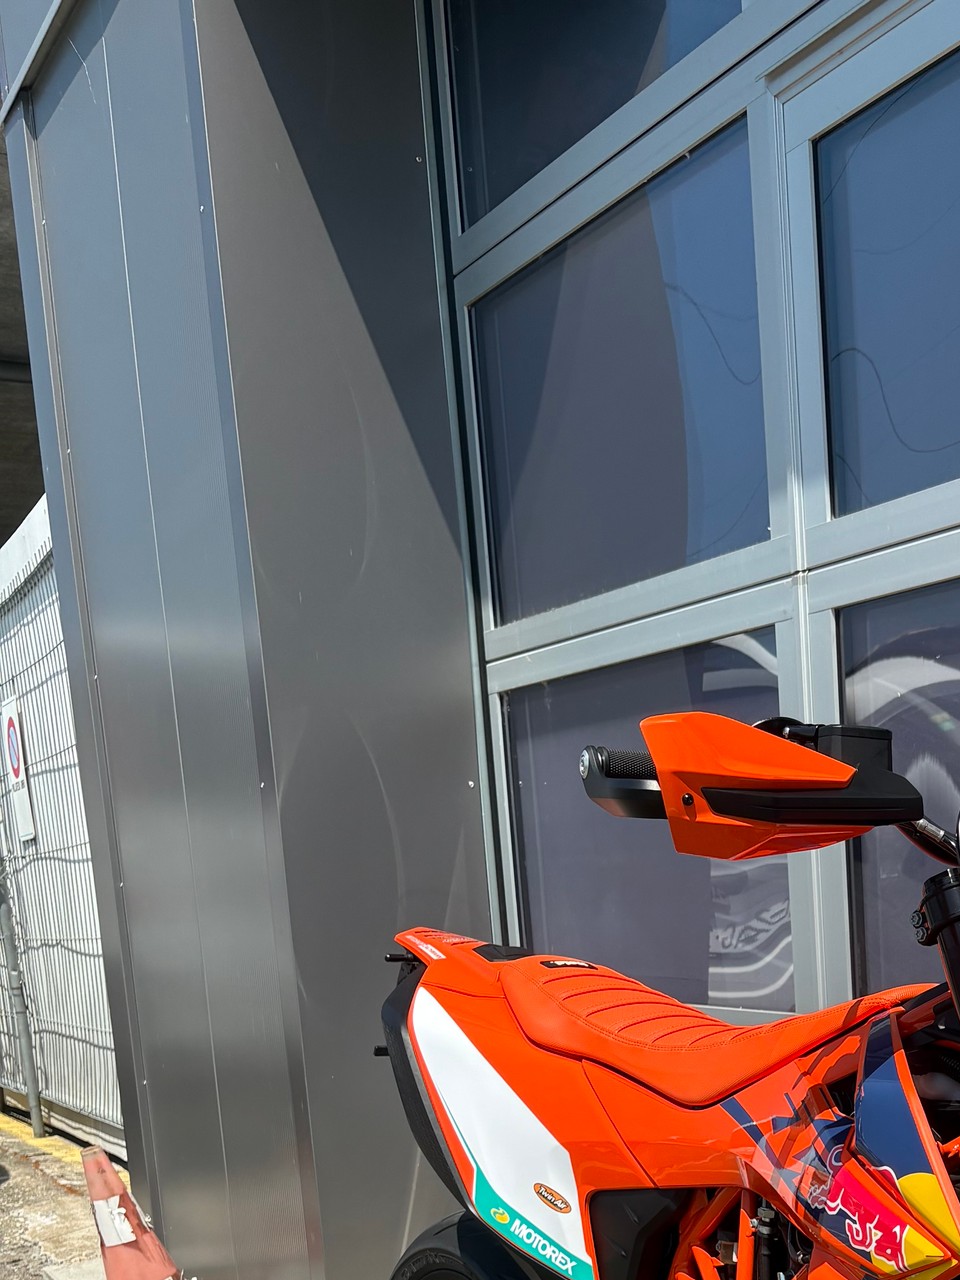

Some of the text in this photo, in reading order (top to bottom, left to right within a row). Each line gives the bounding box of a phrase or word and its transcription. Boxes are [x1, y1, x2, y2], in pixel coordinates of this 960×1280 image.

[539, 1186, 569, 1210] Twin Air
[510, 1218, 577, 1276] MOTOREX
